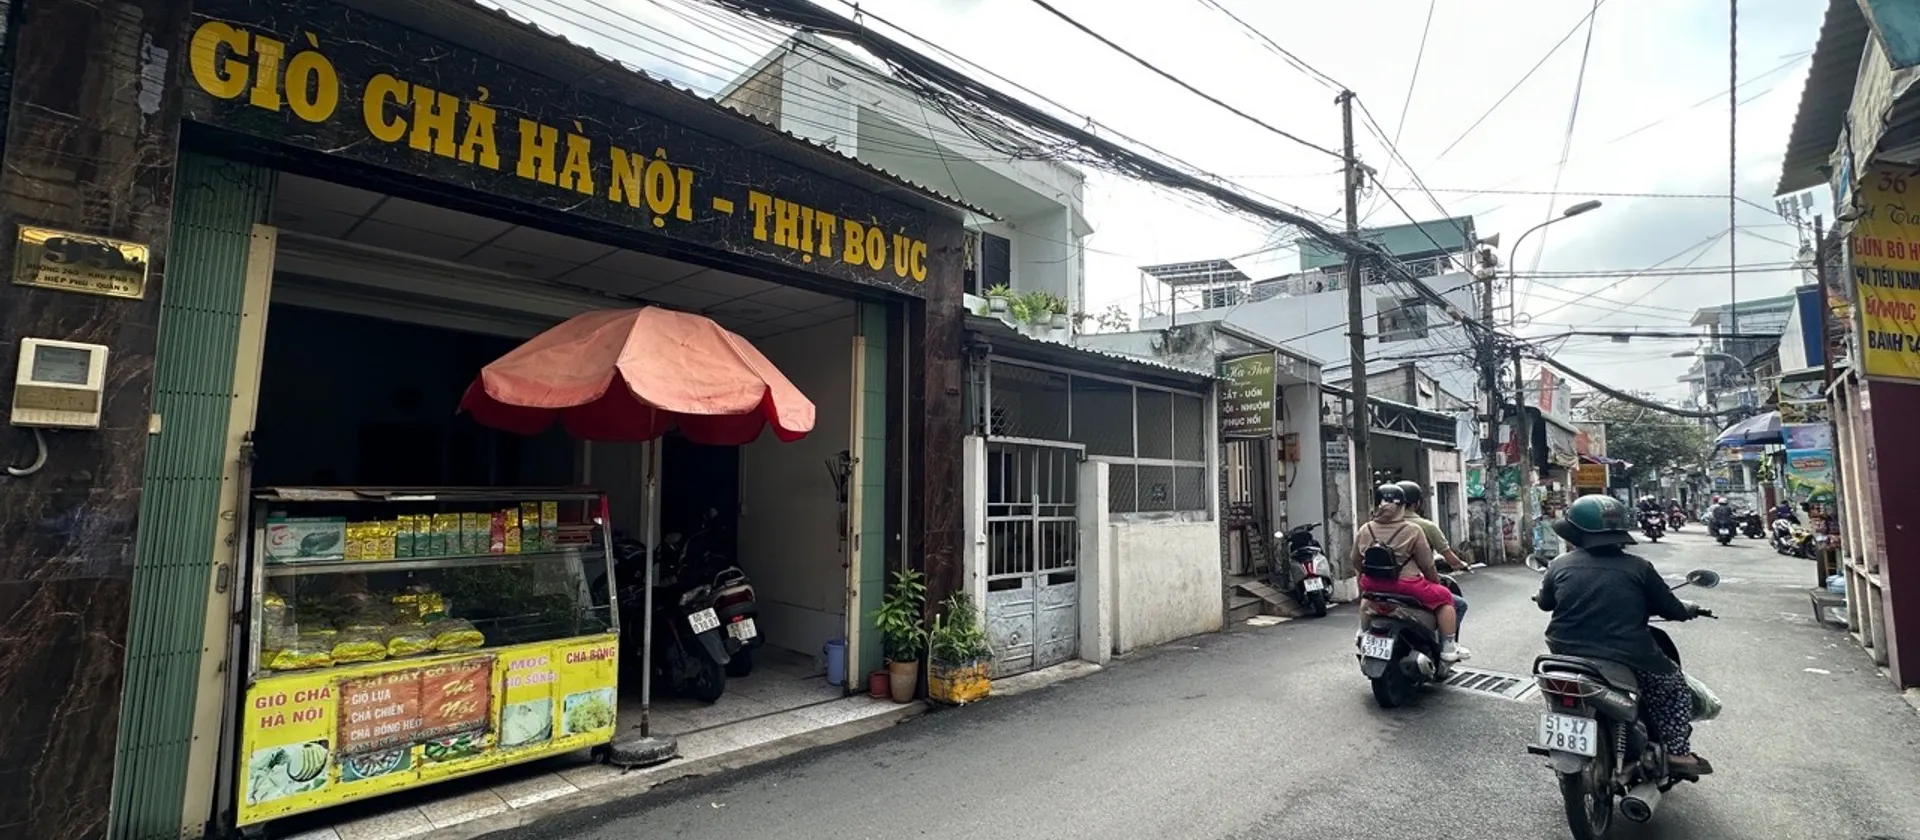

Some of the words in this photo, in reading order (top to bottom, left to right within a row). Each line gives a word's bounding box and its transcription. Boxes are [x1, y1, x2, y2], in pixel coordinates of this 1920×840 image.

[190, 21, 339, 123] GIÒ
[363, 73, 500, 171] CHẢ
[516, 118, 594, 195] HÀ
[609, 147, 694, 228] NỘI
[749, 190, 837, 264] THỊT
[843, 215, 887, 271] BÒ
[893, 227, 928, 282] ÚC
[1887, 236, 1906, 260] BÒ
[44, 274, 68, 284] HIỆP
[96, 280, 120, 291] QUẬN
[1872, 264, 1895, 288] TIẾU
[1868, 326, 1903, 352] BÁNH
[352, 692, 369, 705] GIÒ
[372, 688, 391, 702] LỤA
[442, 679, 475, 698] Hà
[255, 692, 287, 709] GIÒ
[439, 699, 478, 719] Nội
[260, 711, 286, 728] HÀ
[293, 705, 324, 722] NỘI
[1546, 730, 1588, 752] 7883
